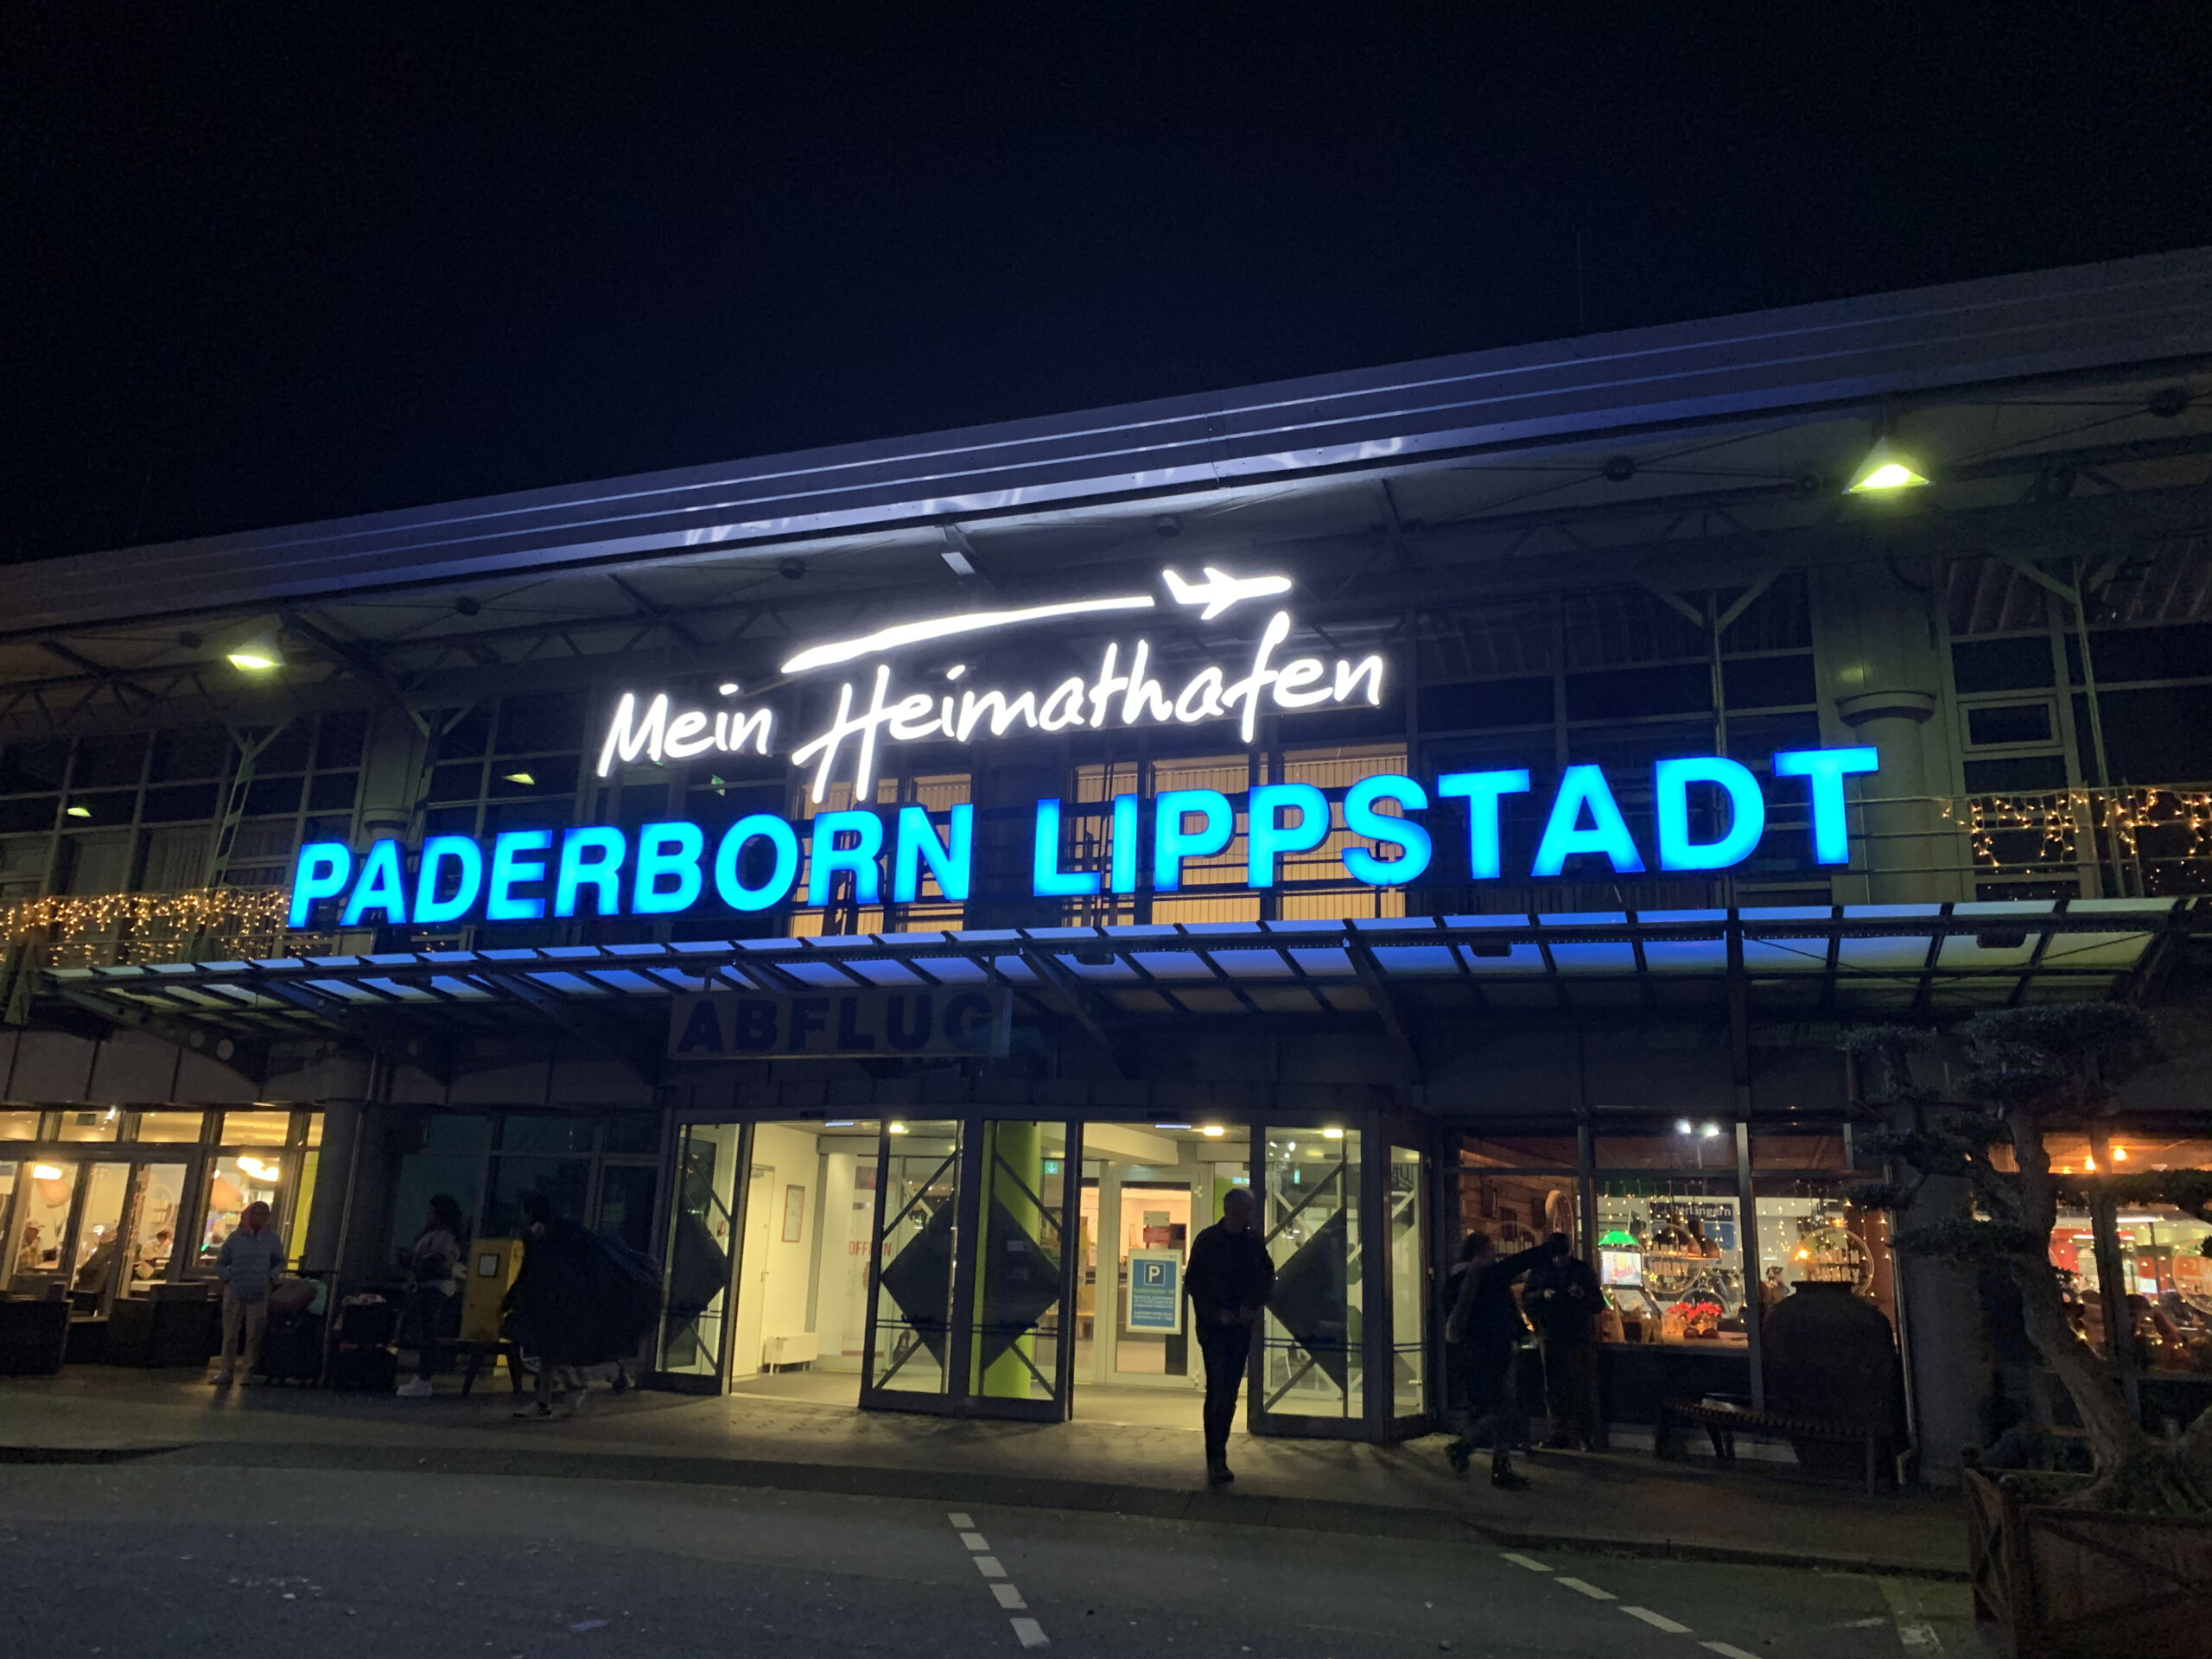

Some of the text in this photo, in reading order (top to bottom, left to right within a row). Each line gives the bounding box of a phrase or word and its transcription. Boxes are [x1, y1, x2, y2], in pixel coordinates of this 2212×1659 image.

[599, 612, 1384, 803] Mein Heimathafen
[288, 747, 1879, 928] PADERBORN LIPPSTADT
[677, 993, 995, 1053] ABFLUG
[1148, 1265, 1160, 1283] P
